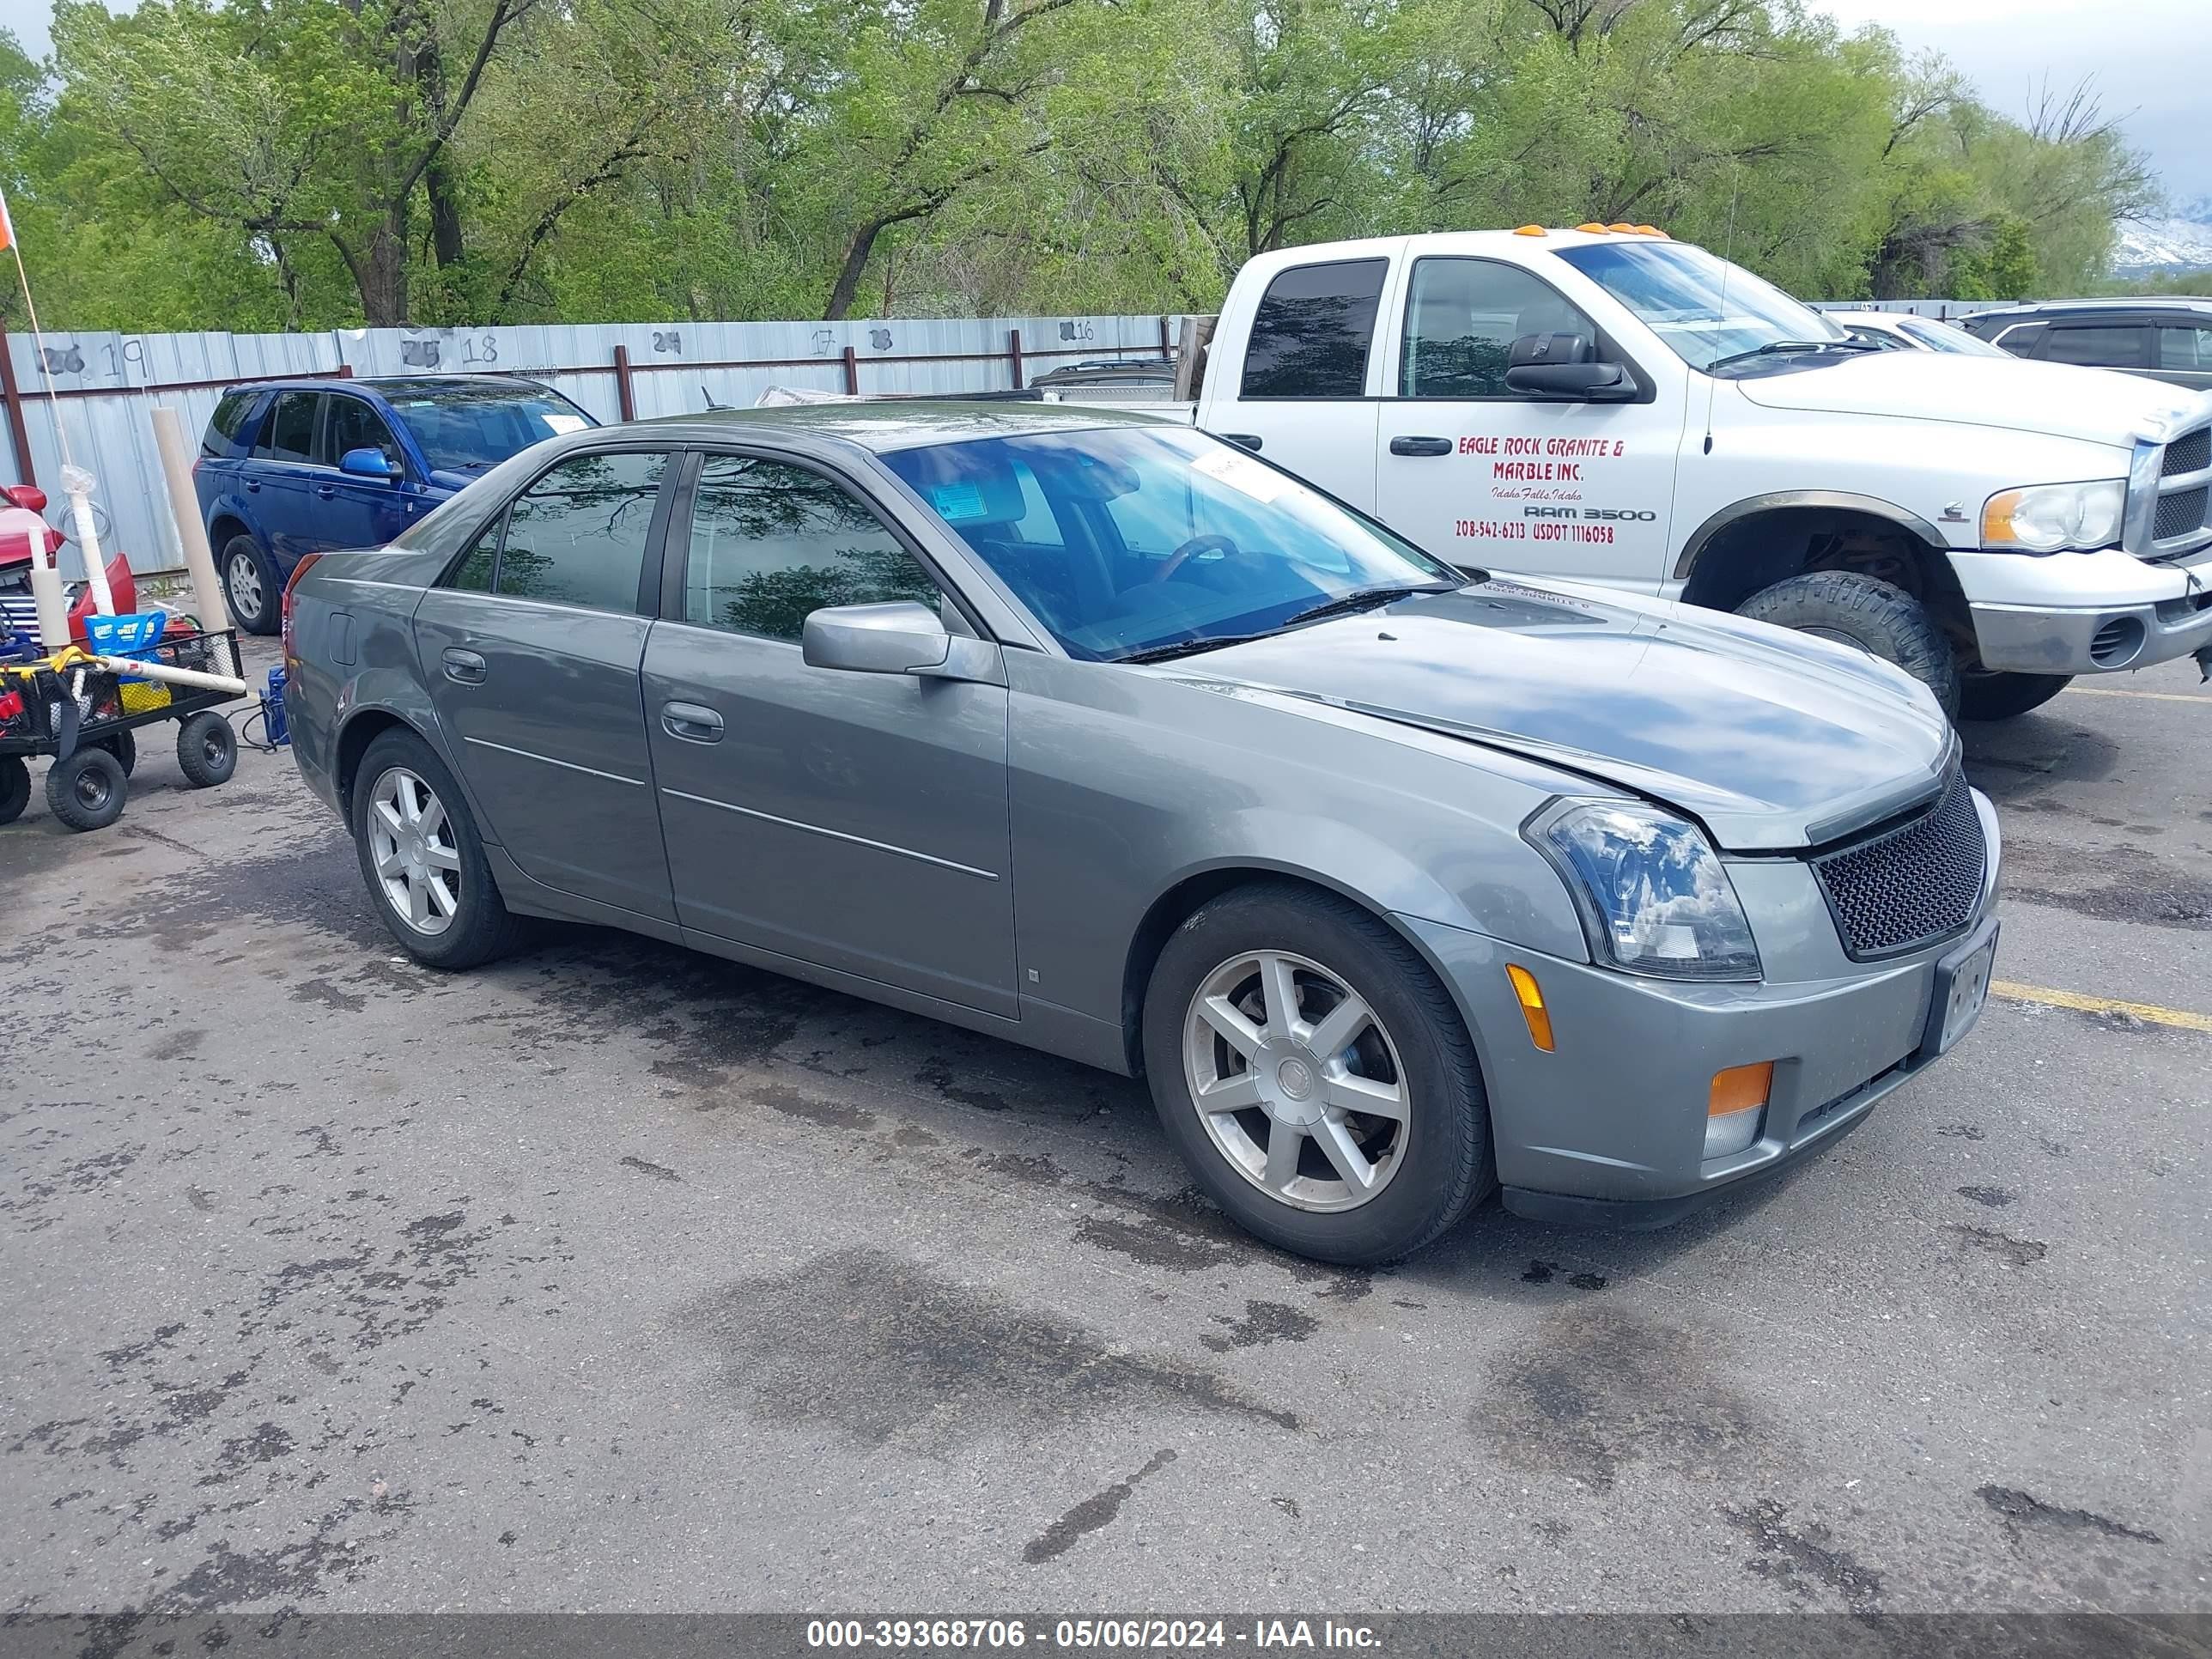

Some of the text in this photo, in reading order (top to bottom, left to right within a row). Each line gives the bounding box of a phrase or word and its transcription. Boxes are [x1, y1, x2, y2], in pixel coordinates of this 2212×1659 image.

[1076, 320, 1094, 341] 16
[463, 336, 498, 362] 18
[810, 329, 836, 356] 17
[100, 340, 147, 378] 19
[1459, 437, 1625, 458] EAGLE ROCK GRANITE &
[1493, 462, 1584, 482] MARBLE INC.
[1492, 486, 1520, 498] Idaho
[1552, 488, 1583, 501] Idaho
[1523, 506, 1656, 521] RAM 3500
[1455, 520, 1613, 544] 208-542-6213 USDOT 1116058
